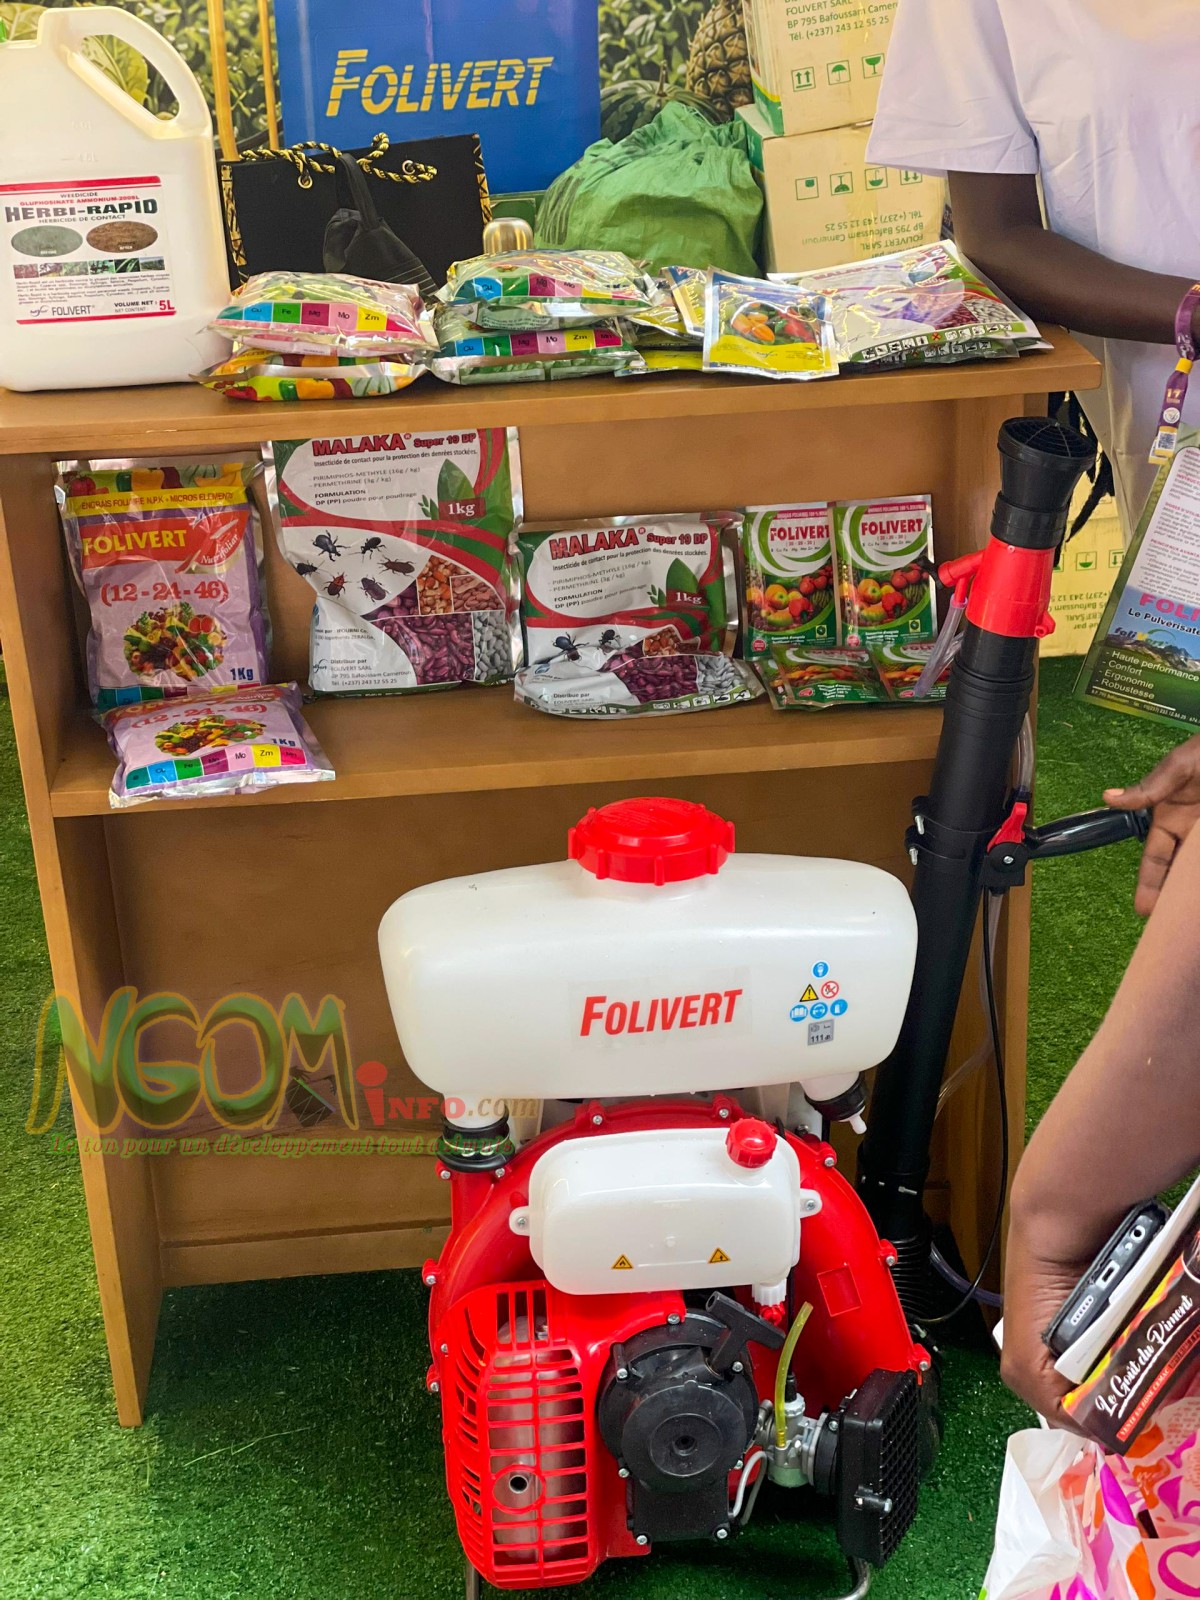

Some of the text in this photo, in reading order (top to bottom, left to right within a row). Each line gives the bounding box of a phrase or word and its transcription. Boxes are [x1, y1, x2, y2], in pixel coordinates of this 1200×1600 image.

[786, 2, 828, 16] FOLIVERT
[787, 2, 898, 29] BP 795 Bafoussam Camer
[790, 16, 890, 41] Tél. (+237) 243 12 55 25
[326, 49, 554, 117] FOLIVERT
[5, 198, 158, 223] HERBI-RAPID
[825, 224, 835, 232] 25
[850, 219, 860, 227] 12
[896, 224, 911, 233] 795
[913, 222, 924, 230] BP
[848, 226, 893, 239] Bafoussam
[862, 242, 882, 250] SARL
[885, 233, 924, 247] FOLIVERT
[159, 300, 175, 311] 5L
[338, 311, 350, 319] Mo
[1167, 388, 1182, 398] 17
[413, 438, 444, 449] Super
[462, 433, 477, 443] DP
[314, 458, 342, 467] Insecticide
[351, 455, 371, 464] contact
[372, 454, 385, 462] pour
[392, 452, 420, 461] protection
[170, 494, 198, 503] MICROS
[315, 489, 366, 498] FORMULATION
[448, 503, 476, 516] 1kg
[770, 525, 830, 541] FOLIVERT
[861, 518, 923, 536] FOLIVERT
[82, 529, 187, 556] FOLIVERT
[646, 533, 677, 545] Super
[694, 532, 708, 544] DP
[553, 560, 580, 571] Insecticide
[581, 558, 588, 566] de
[588, 556, 606, 565] contact
[606, 554, 619, 562] pour
[626, 547, 651, 557] protection
[101, 580, 229, 606] (12 24 46)
[554, 589, 603, 602] FORMULATION
[675, 592, 702, 604] 1kg
[1054, 602, 1096, 611] Bafoussam
[1128, 608, 1141, 618] Le
[1108, 660, 1142, 676] Confort
[1112, 650, 1200, 682] Haute performance
[230, 667, 254, 681] 1Kg
[1104, 669, 1154, 689] Ergonomie
[1101, 678, 1155, 699] Robustesse
[271, 738, 296, 746] 1Kg
[580, 988, 743, 1037] FOLIVERT
[811, 1034, 824, 1042] 111
[1095, 1394, 1116, 1418] Le
[1110, 1360, 1141, 1398] Goût
[1138, 1342, 1154, 1366] du
[1147, 1295, 1193, 1345] Piment
